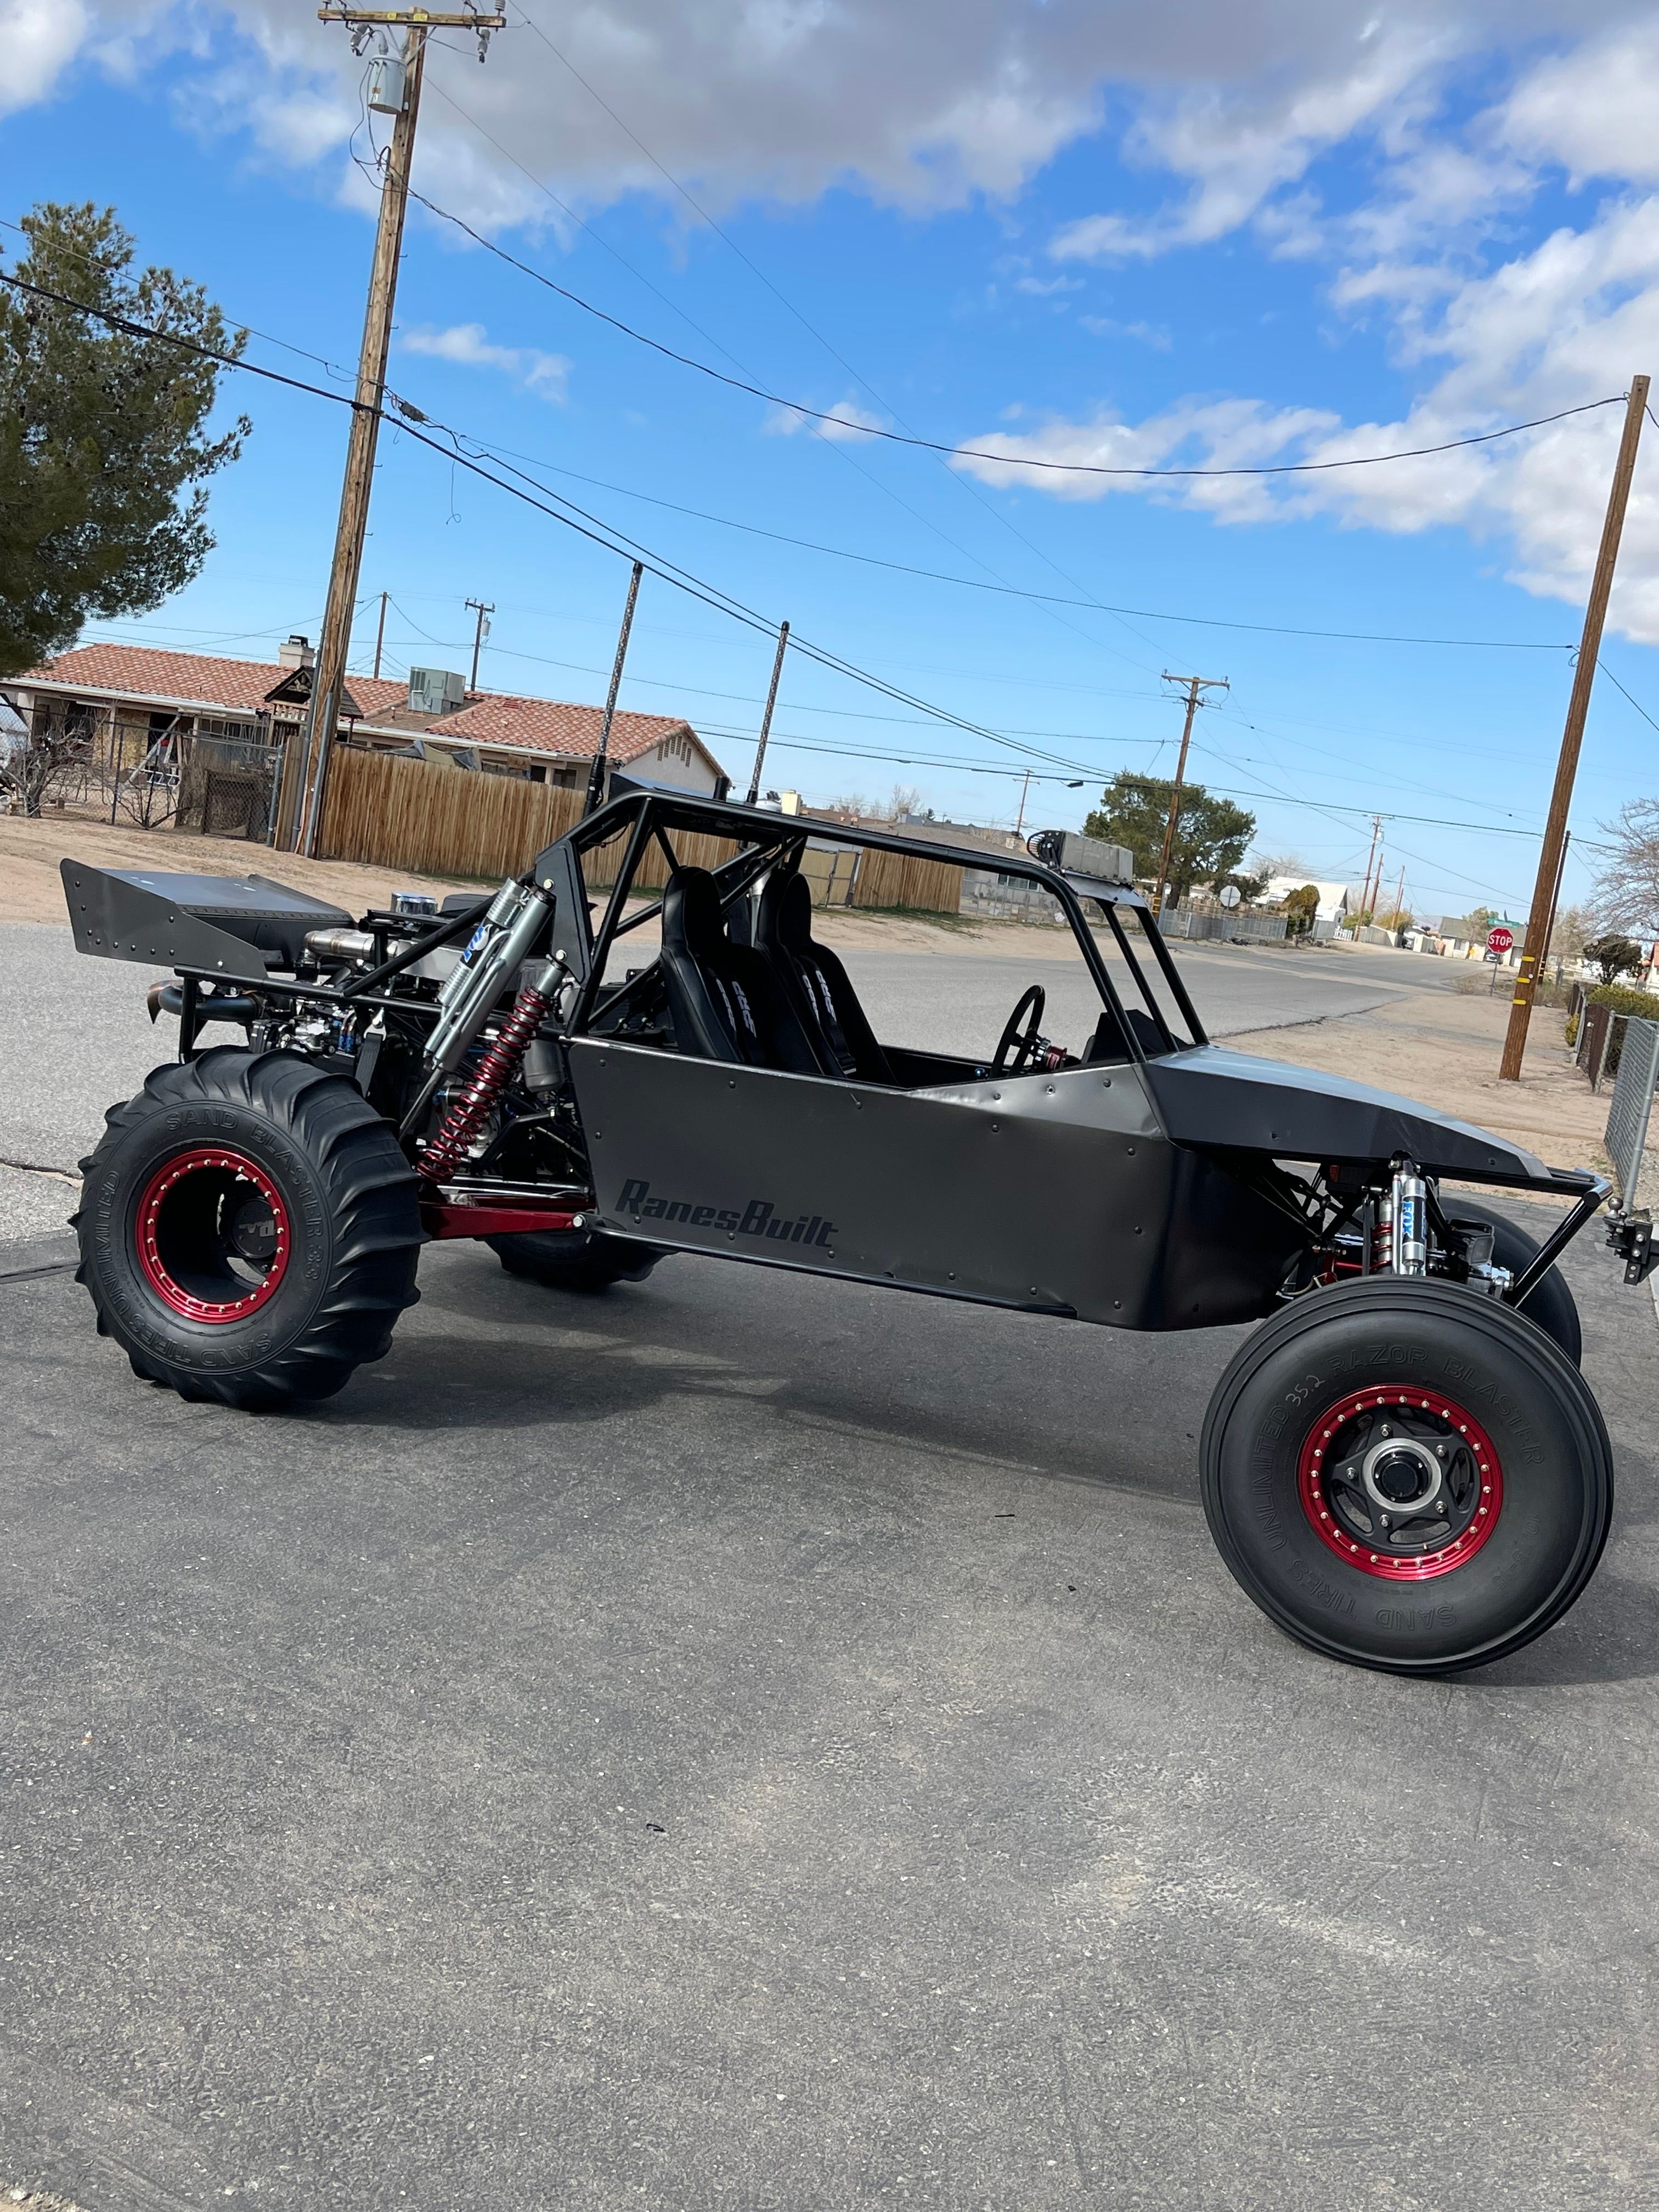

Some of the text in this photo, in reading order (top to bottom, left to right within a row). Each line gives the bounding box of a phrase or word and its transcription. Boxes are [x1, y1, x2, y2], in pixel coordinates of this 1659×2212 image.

[1488, 935, 1512, 946] STOP
[166, 1107, 239, 1131] SAND
[249, 1124, 323, 1238] BLASTER
[614, 1178, 838, 1248] RanesBuilt
[1402, 1201, 1414, 1239] FOX
[95, 1170, 131, 1315] UNLIMITED
[129, 1313, 191, 1364] TIRES
[201, 1333, 272, 1367] SAND
[1285, 1374, 1326, 1407] 35.2
[1326, 1344, 1545, 1464] RAZOR BLASTER
[1252, 1404, 1289, 1552] UNLIMITED
[1290, 1559, 1357, 1621] TIRES
[1376, 1604, 1457, 1630] SAND
